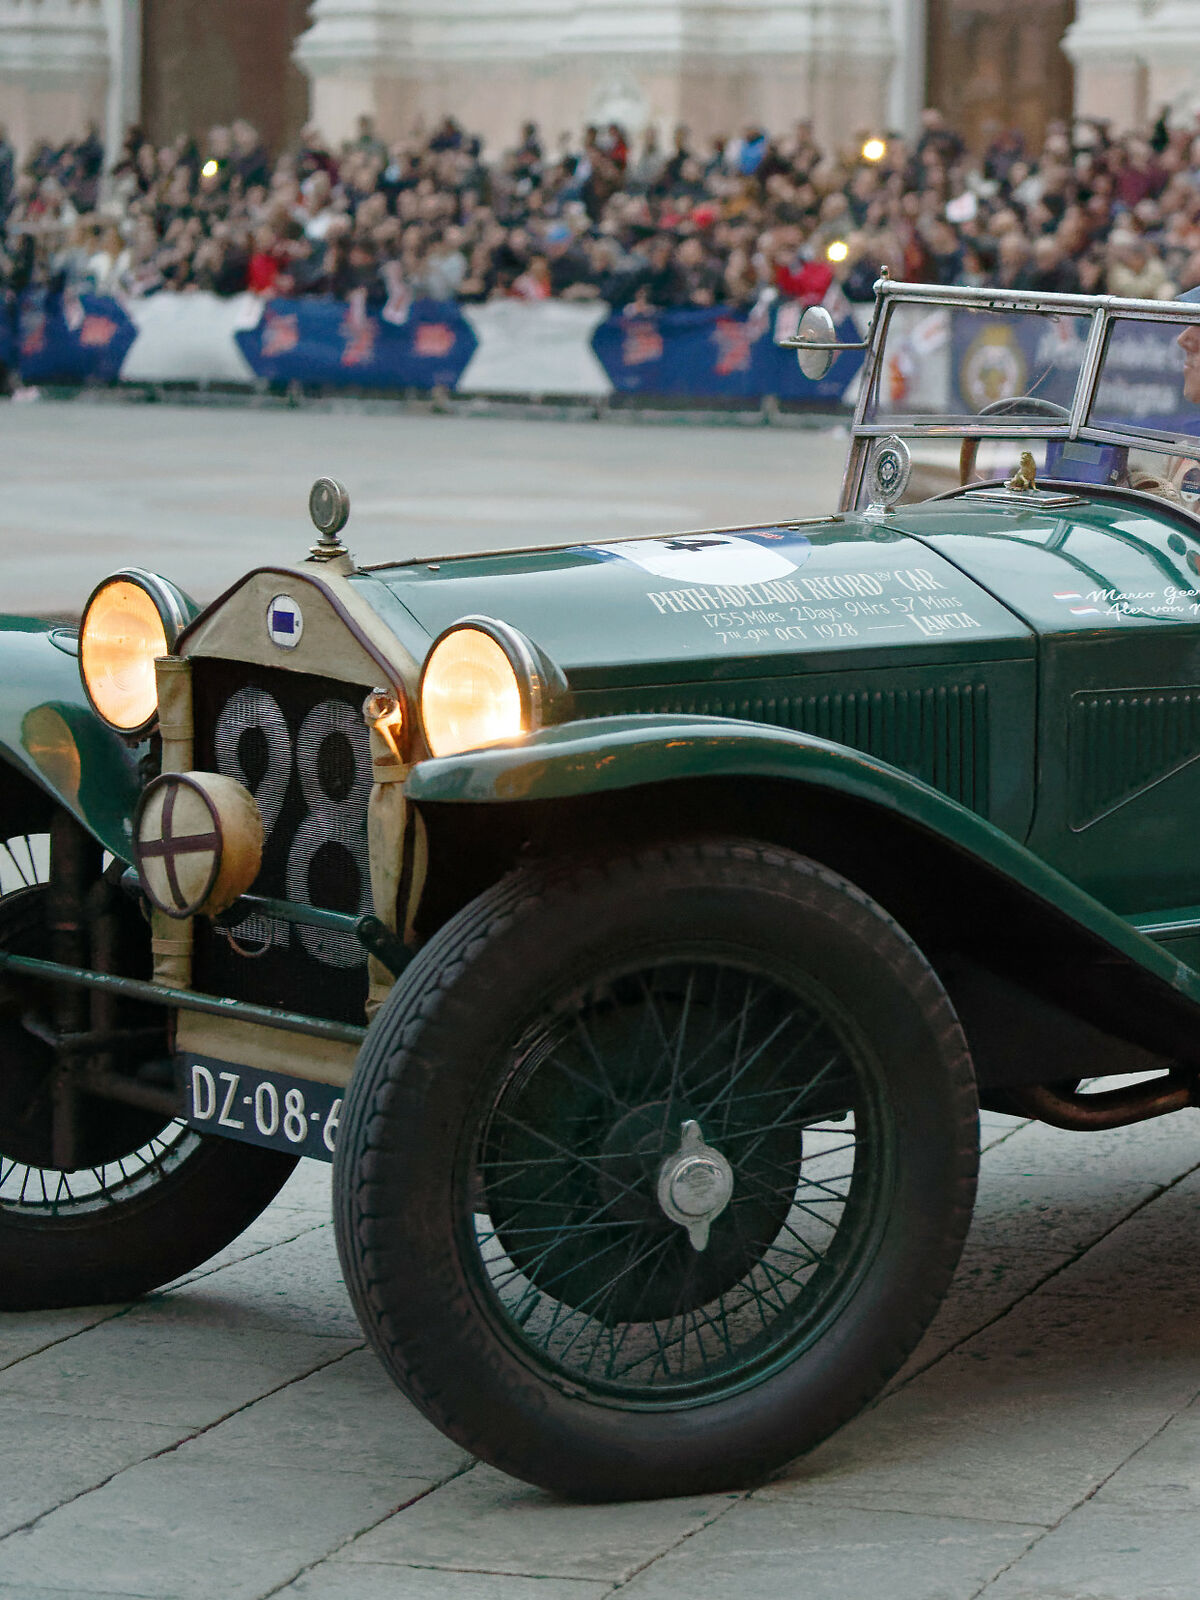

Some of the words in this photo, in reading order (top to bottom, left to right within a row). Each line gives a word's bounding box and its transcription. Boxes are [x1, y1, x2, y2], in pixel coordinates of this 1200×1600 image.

[647, 579, 812, 614] PERTH-ADELAIDE
[801, 573, 883, 601] RECORD
[894, 569, 949, 592] CAR
[1085, 588, 1155, 601] Marco
[891, 597, 914, 613] 57
[919, 595, 963, 611] Mins
[1104, 602, 1150, 621] Alex
[1151, 606, 1184, 614] von
[775, 626, 807, 641] OCT
[813, 622, 858, 639] 1928
[907, 612, 981, 636] LANCIA
[215, 686, 372, 968] 28
